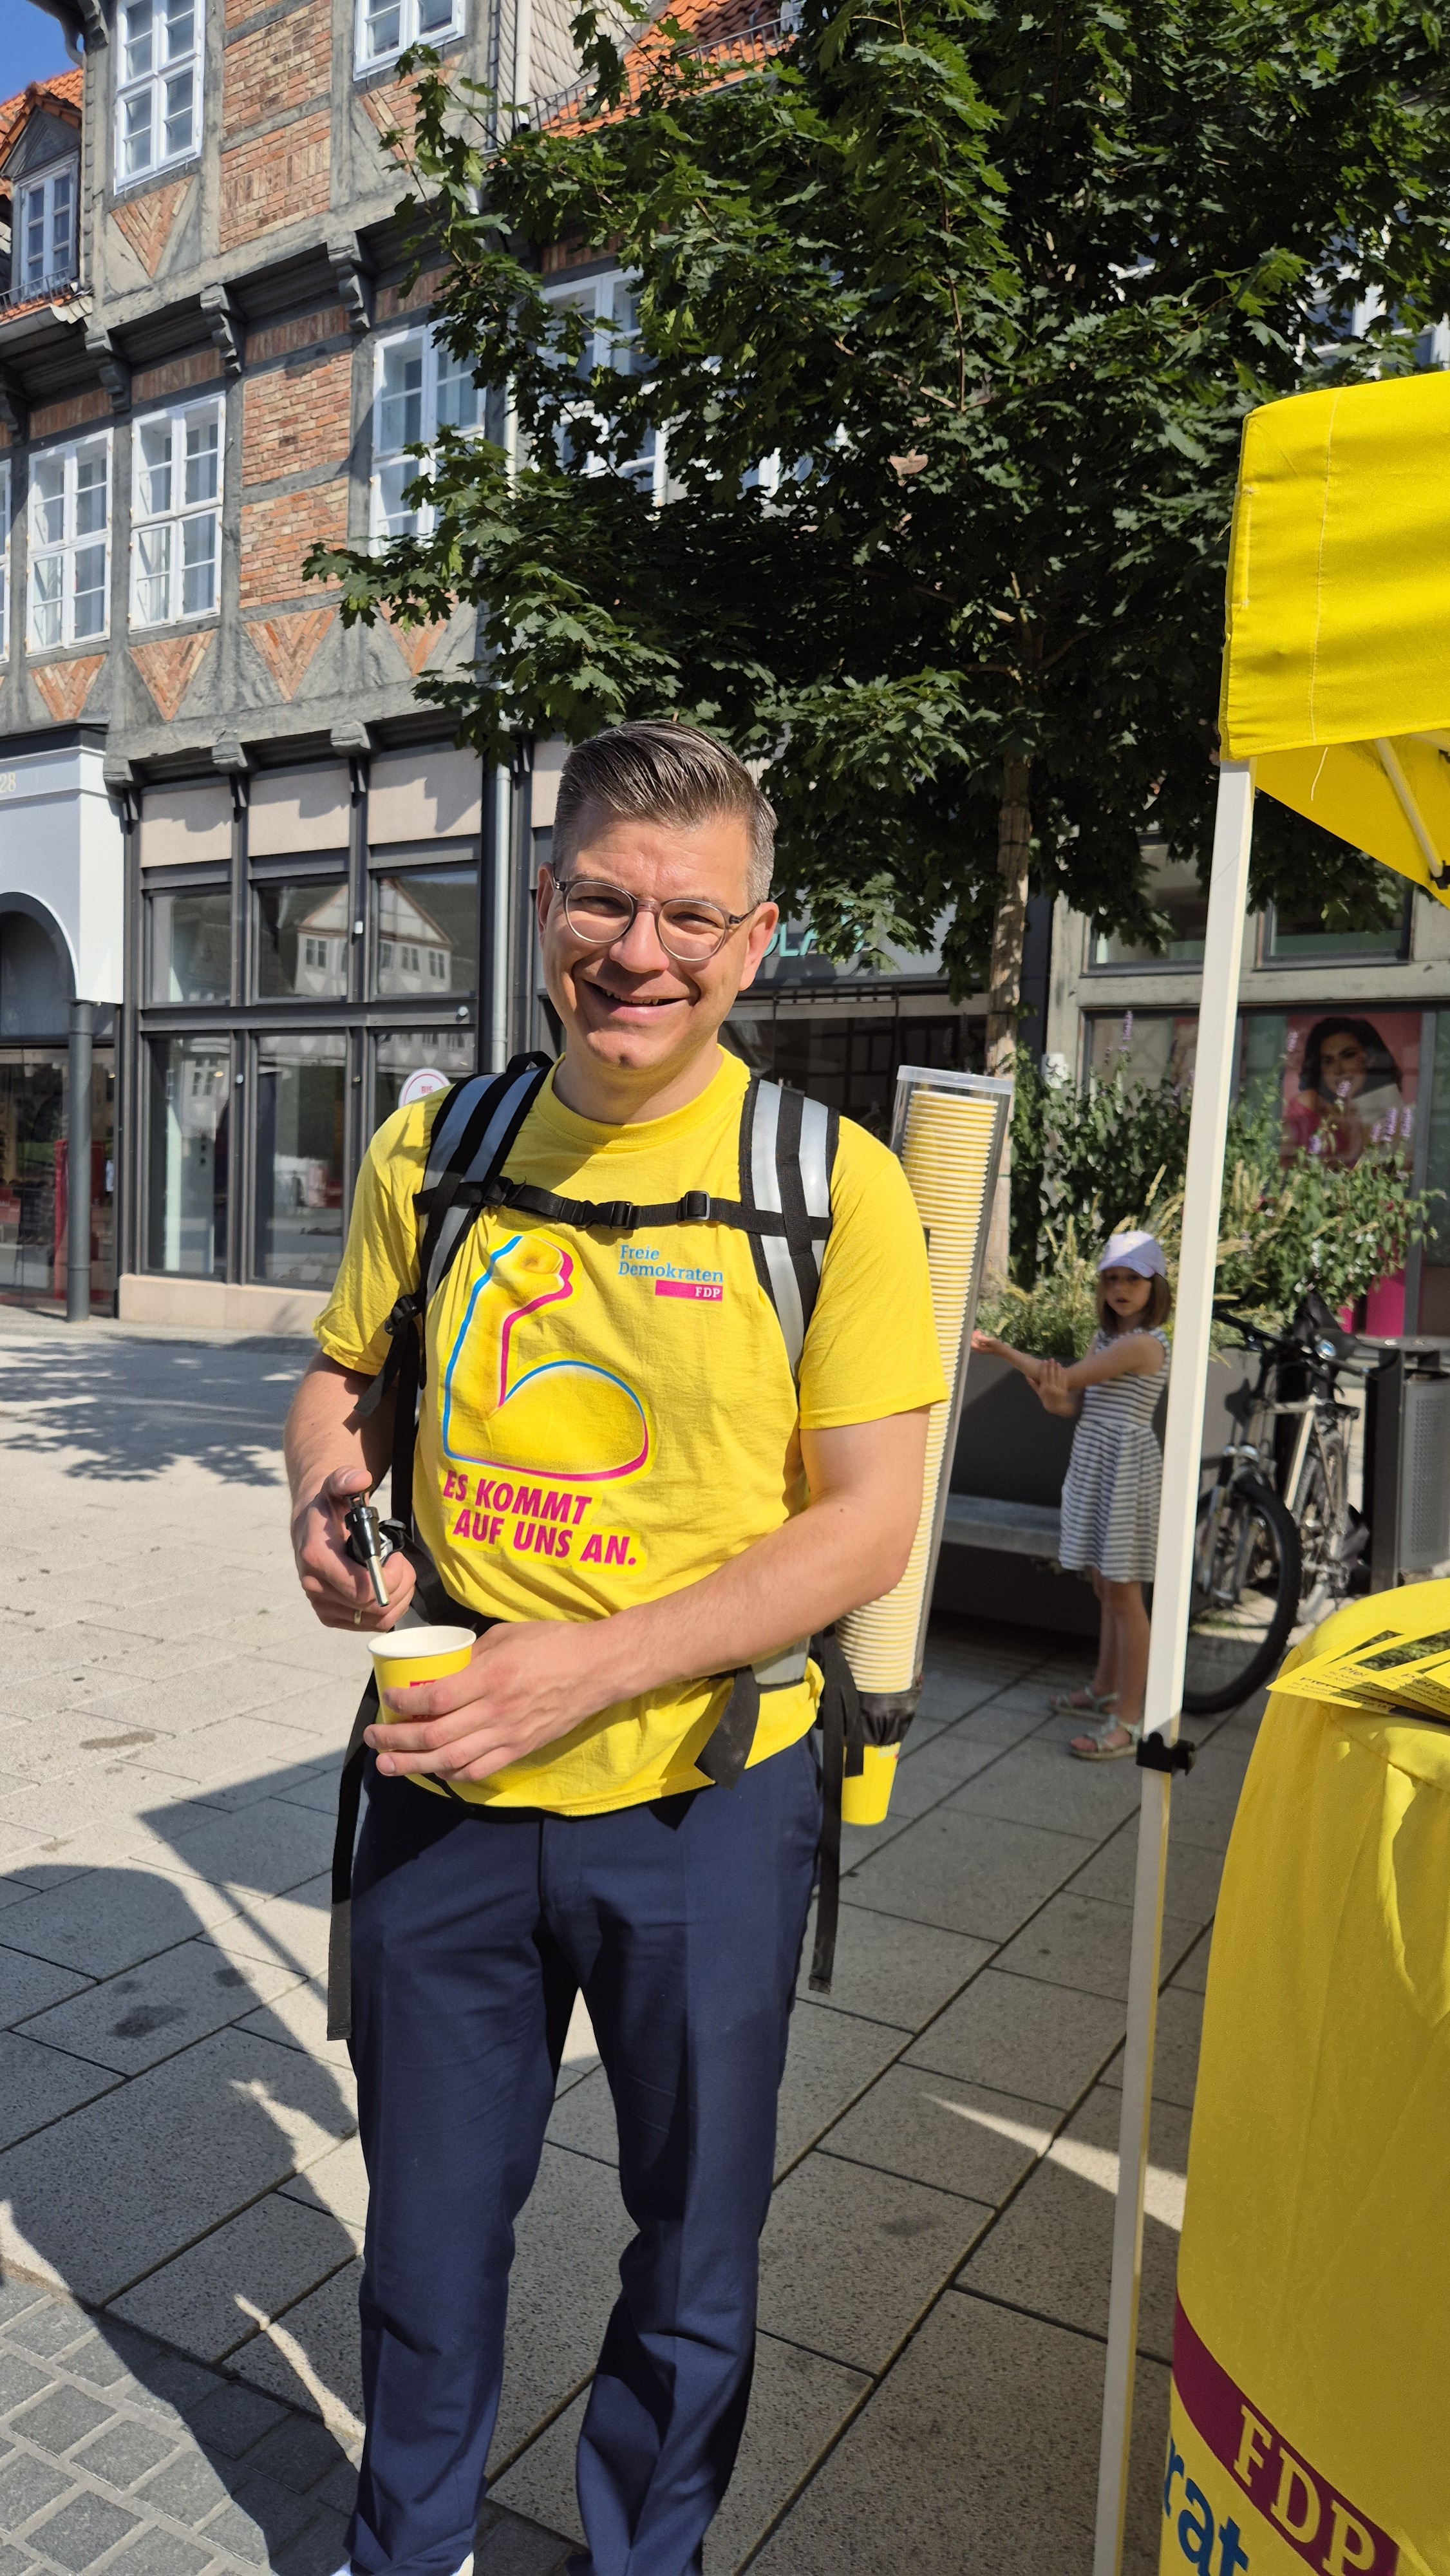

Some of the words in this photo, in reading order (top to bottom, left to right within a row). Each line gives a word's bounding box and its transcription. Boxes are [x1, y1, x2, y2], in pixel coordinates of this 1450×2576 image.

[620, 1244, 660, 1260] Freie
[618, 1261, 724, 1283] Demokraten
[695, 1286, 720, 1298] FDP
[443, 1469, 469, 1502] ES
[475, 1477, 592, 1526] KOMMT
[453, 1508, 505, 1546] AUF
[513, 1520, 573, 1559] UNS
[579, 1533, 636, 1566] AN.
[1234, 2403, 1376, 2576] FDP
